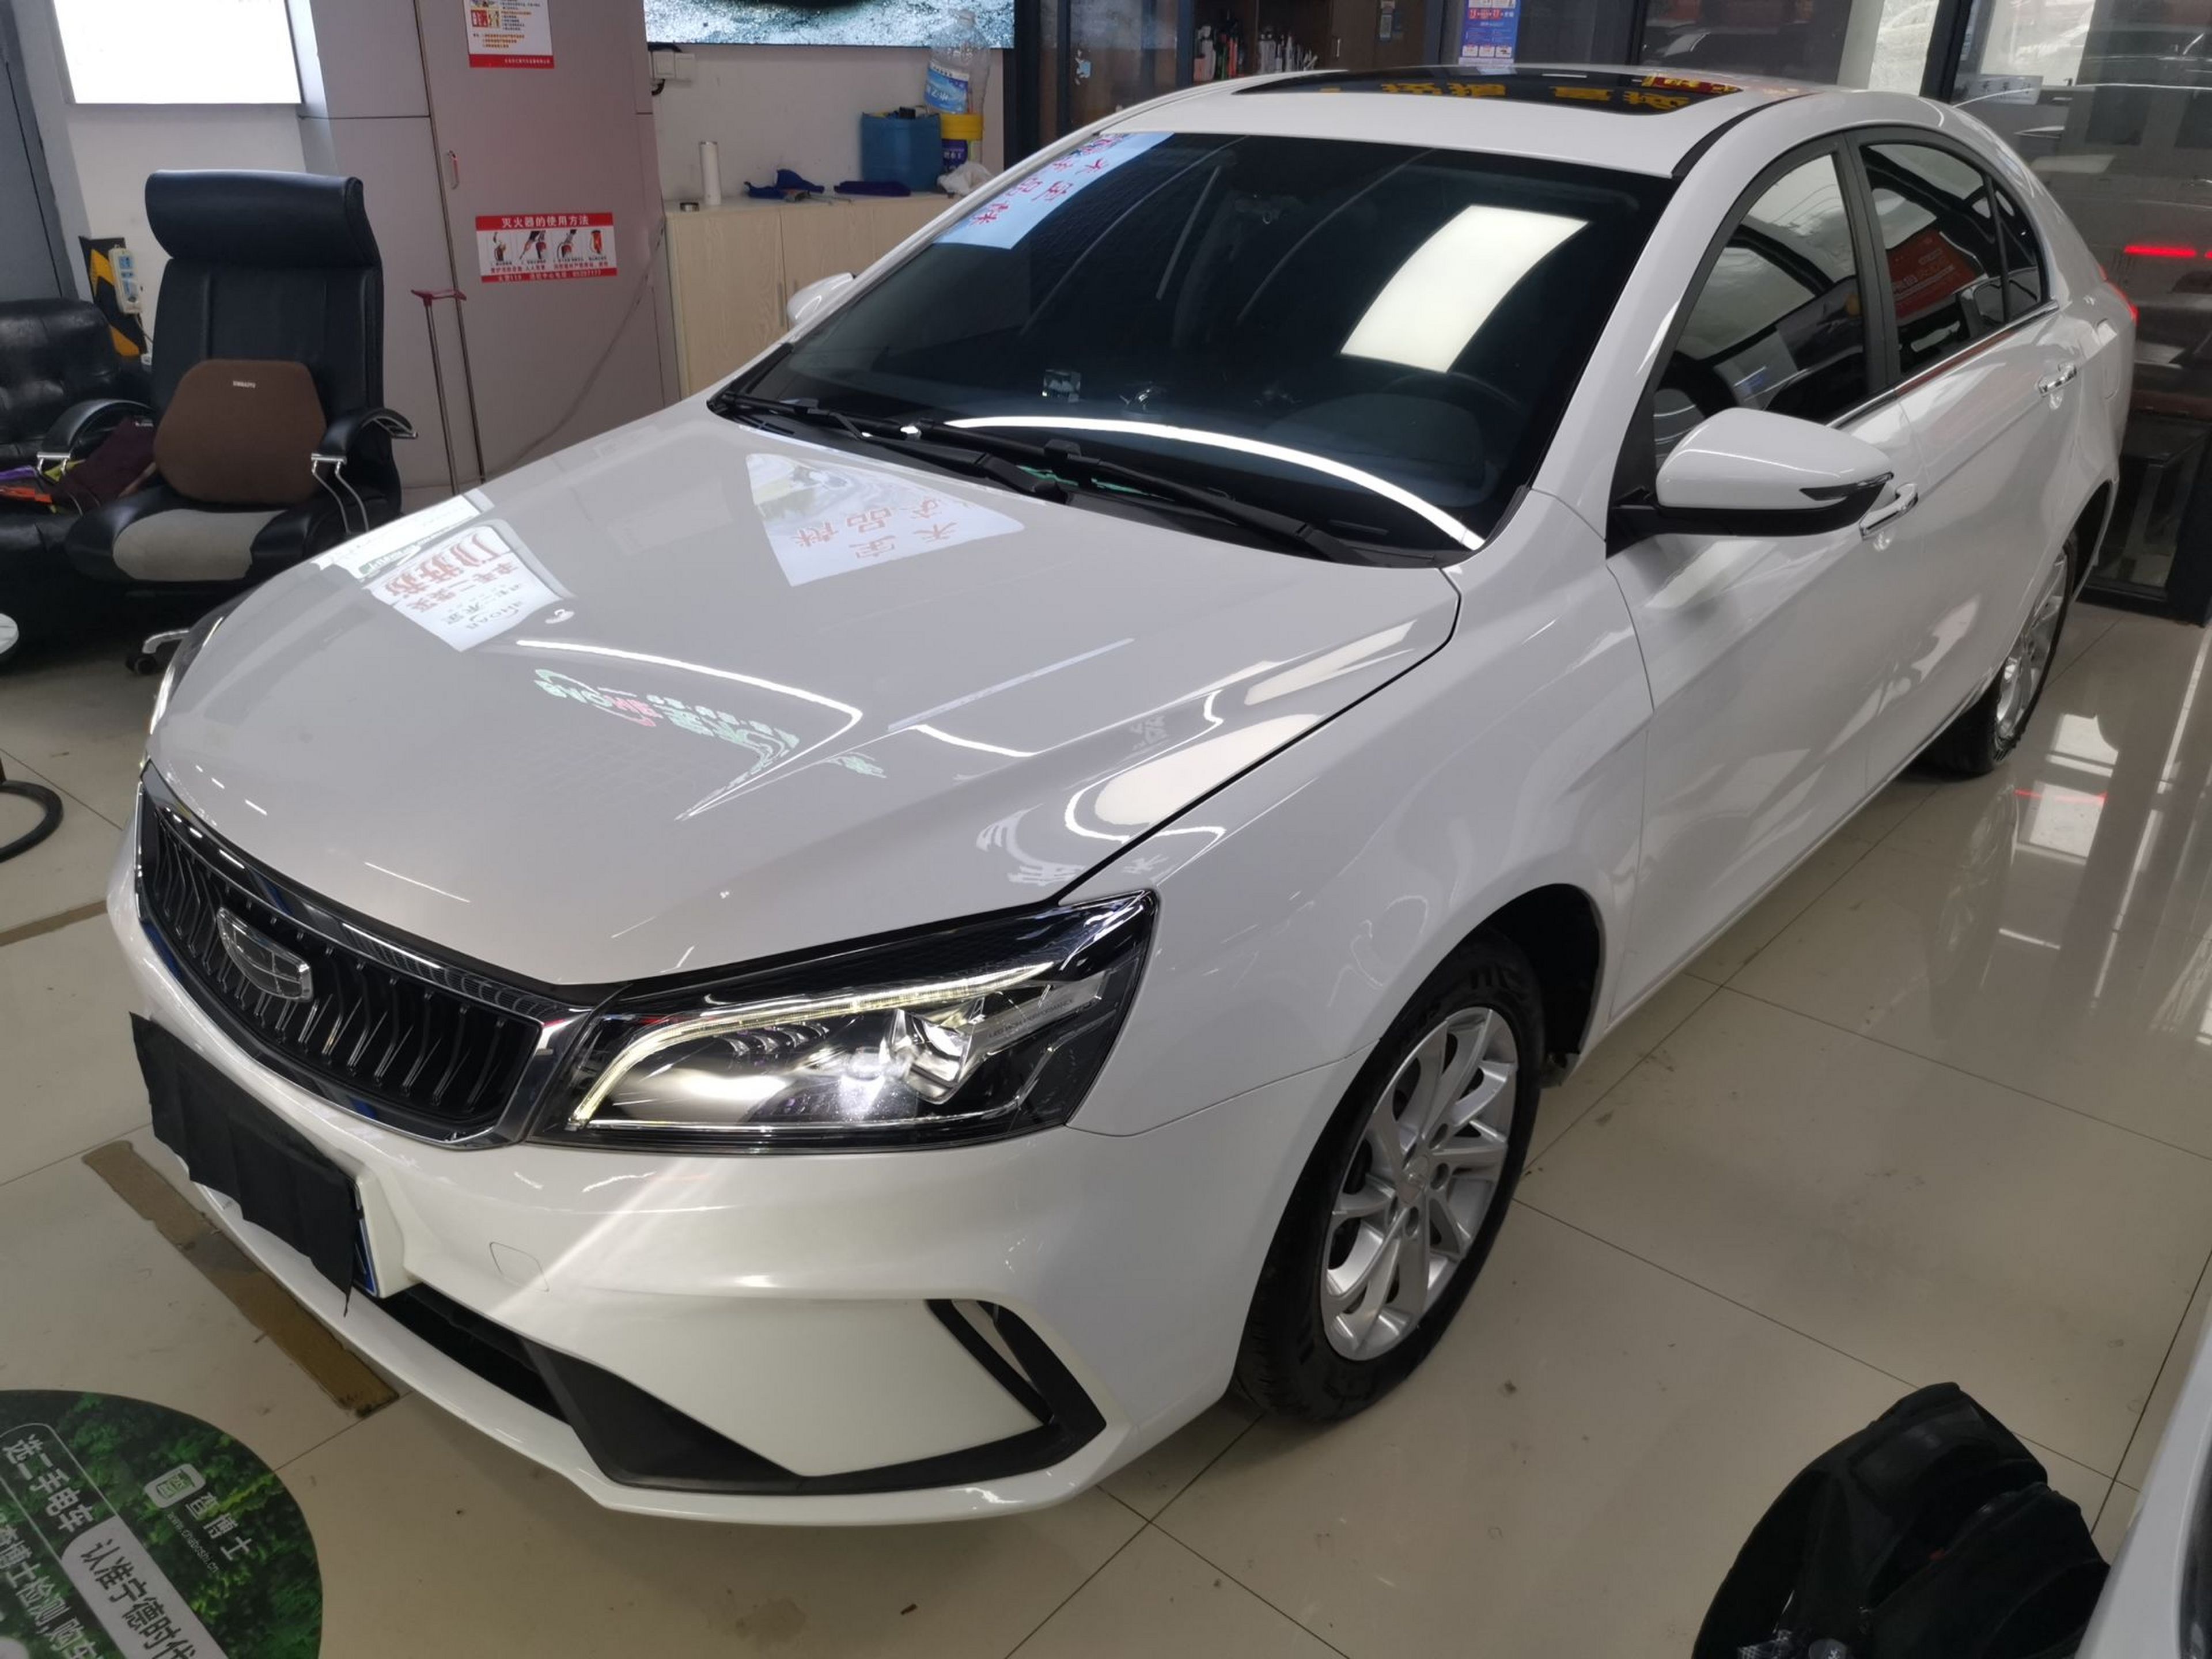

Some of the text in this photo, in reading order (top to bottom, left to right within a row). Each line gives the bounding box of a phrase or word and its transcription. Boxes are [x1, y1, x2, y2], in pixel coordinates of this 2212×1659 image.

[502, 215, 589, 229] 灭火器的使用方法
[2, 1434, 94, 1533] 选二手电车
[185, 1491, 252, 1560] 查博士
